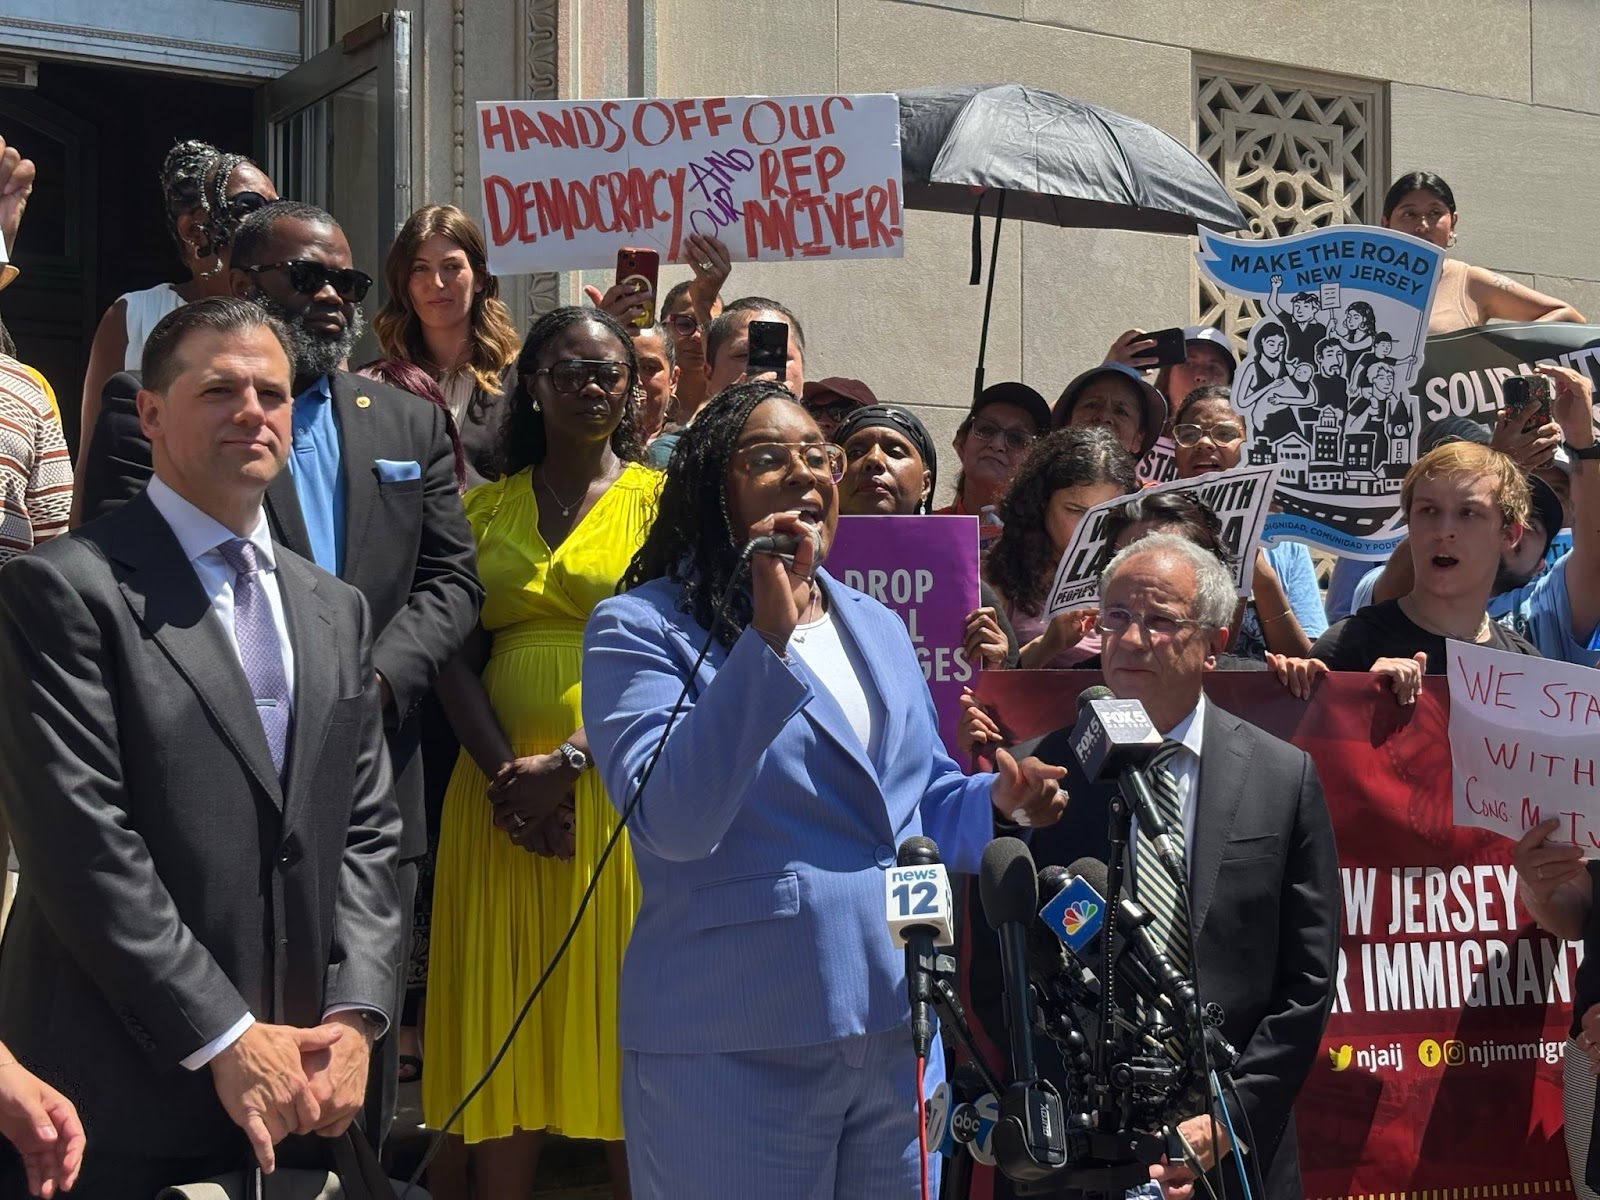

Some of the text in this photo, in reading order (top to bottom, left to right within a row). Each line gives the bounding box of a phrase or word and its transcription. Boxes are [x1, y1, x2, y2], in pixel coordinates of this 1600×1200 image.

[481, 102, 626, 153] HANDS
[632, 98, 733, 146] OFF
[688, 148, 754, 202] AND
[759, 145, 845, 199] REP
[483, 167, 686, 262] DEMOCRACY
[690, 188, 744, 239] OUR
[1230, 240, 1429, 276] MAKE THE ROAD
[1296, 264, 1424, 296] NEW JERSEY
[1201, 478, 1259, 512] WITH
[1264, 521, 1308, 533] DIGNIDAD,
[1310, 527, 1363, 550] COMUNIDAD
[1365, 543, 1371, 551] Y
[844, 569, 934, 604] DROP
[1457, 656, 1524, 709] WE
[1484, 737, 1595, 787] WITH
[892, 869, 937, 882] news
[892, 881, 938, 916] 12
[1338, 865, 1519, 935] W JERSEY
[1357, 1037, 1567, 1072] njaij njimmigr
[953, 1112, 981, 1131] abc
